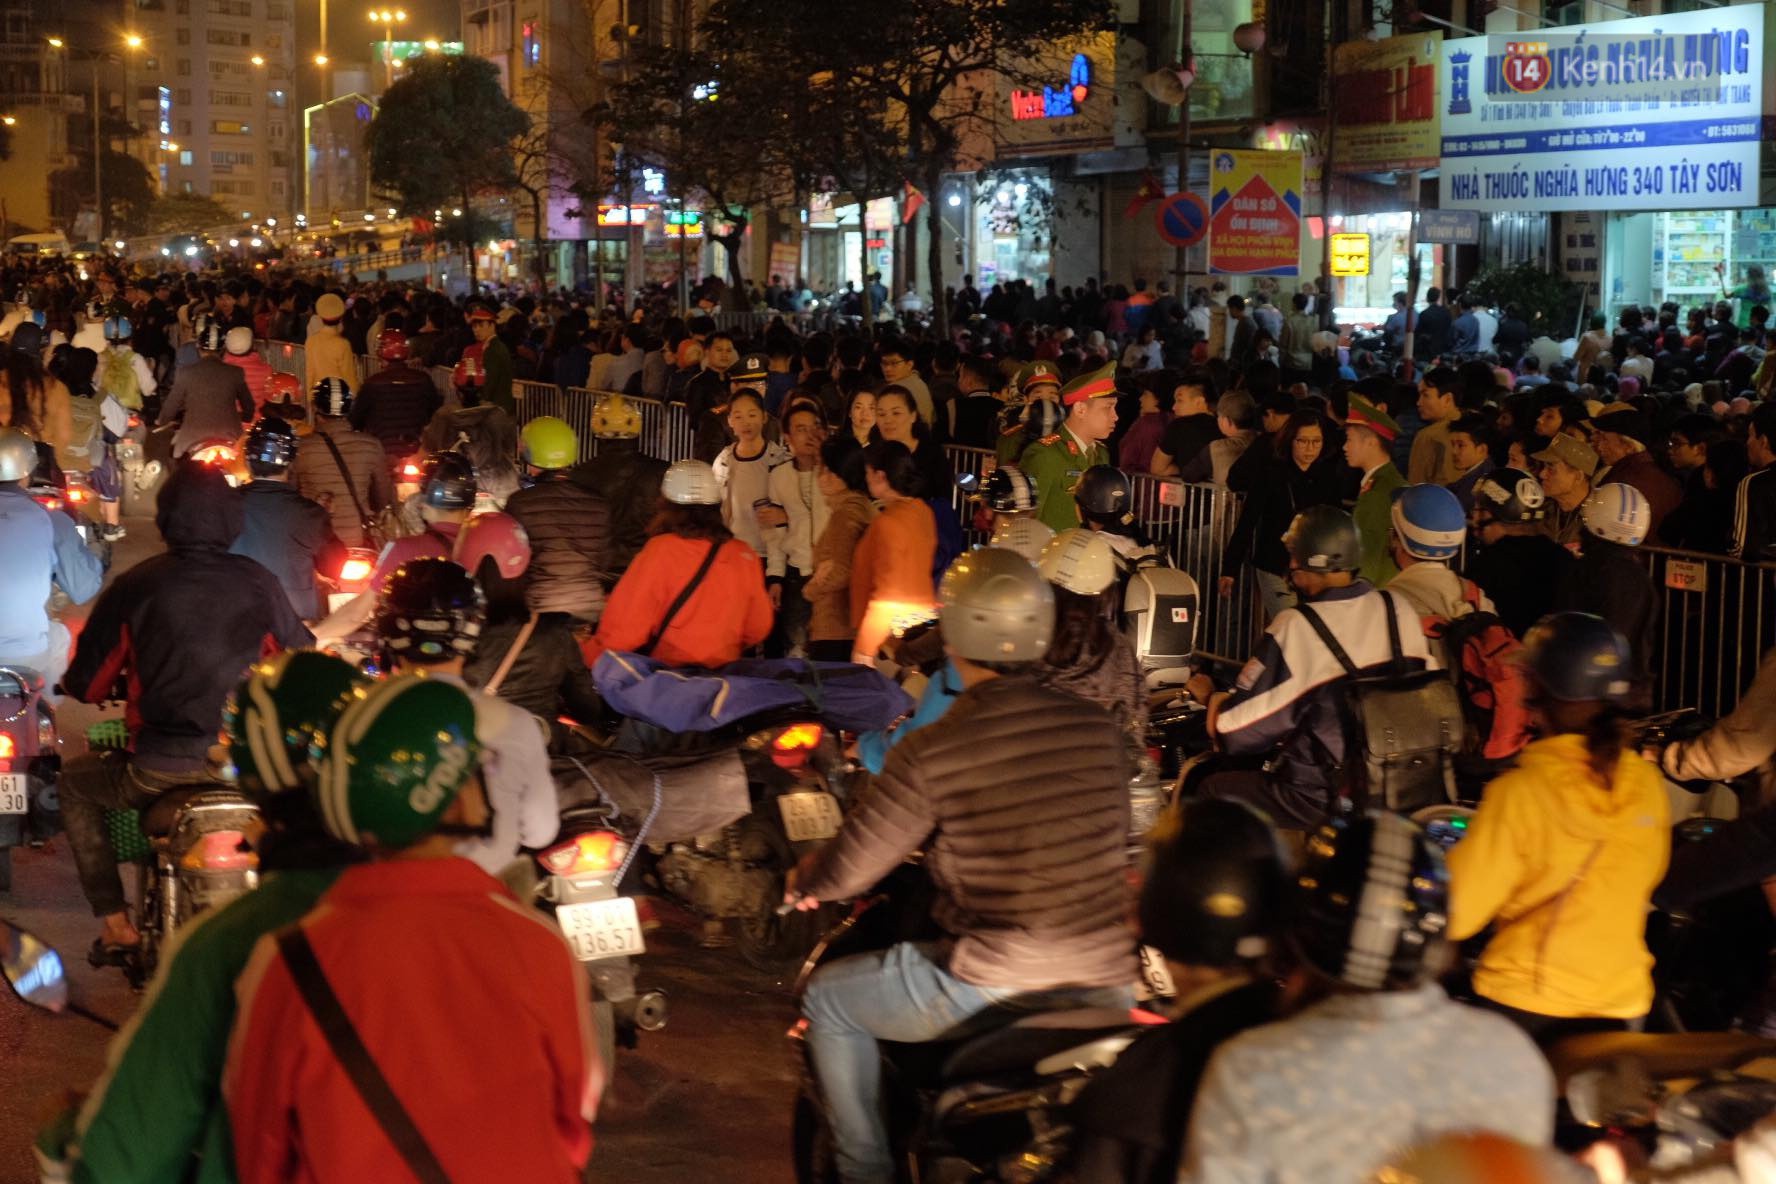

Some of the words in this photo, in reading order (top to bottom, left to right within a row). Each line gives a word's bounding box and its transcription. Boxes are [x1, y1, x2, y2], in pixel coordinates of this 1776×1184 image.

[1452, 166, 1480, 200] NHÀ
[1484, 162, 1529, 200] THUỐC
[1534, 163, 1579, 198] NGHĨA
[1585, 164, 1628, 197] HƯNG
[1633, 165, 1663, 196] 340
[1670, 157, 1700, 194] TÂY
[1706, 160, 1743, 193] SƠN
